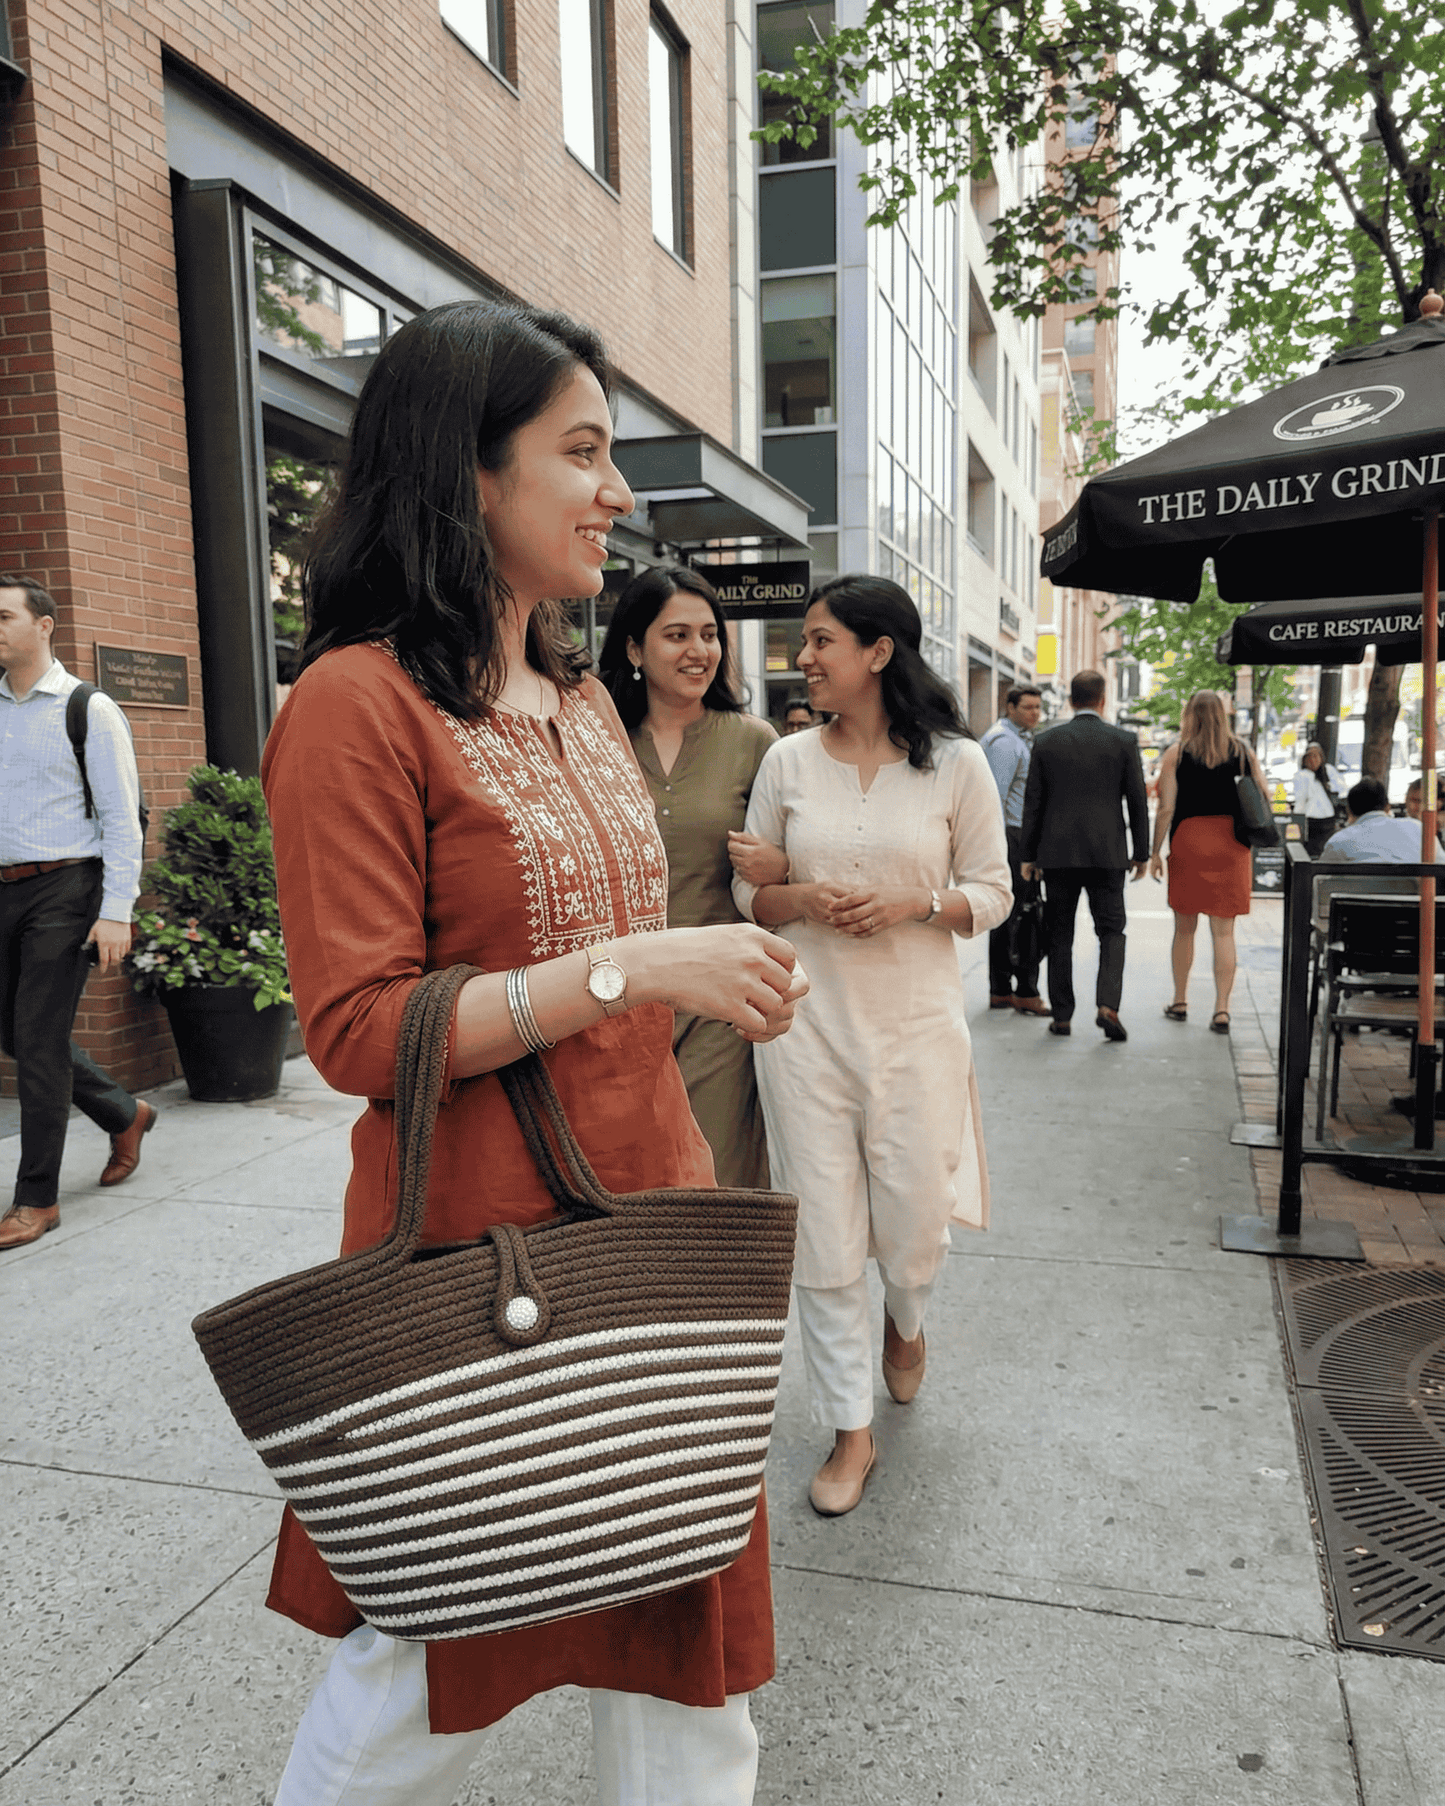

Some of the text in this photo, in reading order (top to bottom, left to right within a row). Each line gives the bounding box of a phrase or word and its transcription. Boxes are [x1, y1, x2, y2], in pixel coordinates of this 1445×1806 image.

[1137, 489, 1207, 524] THE
[1215, 472, 1323, 516] DAILY
[716, 583, 806, 600] AILY GRIND
[1268, 622, 1320, 641] CAFE
